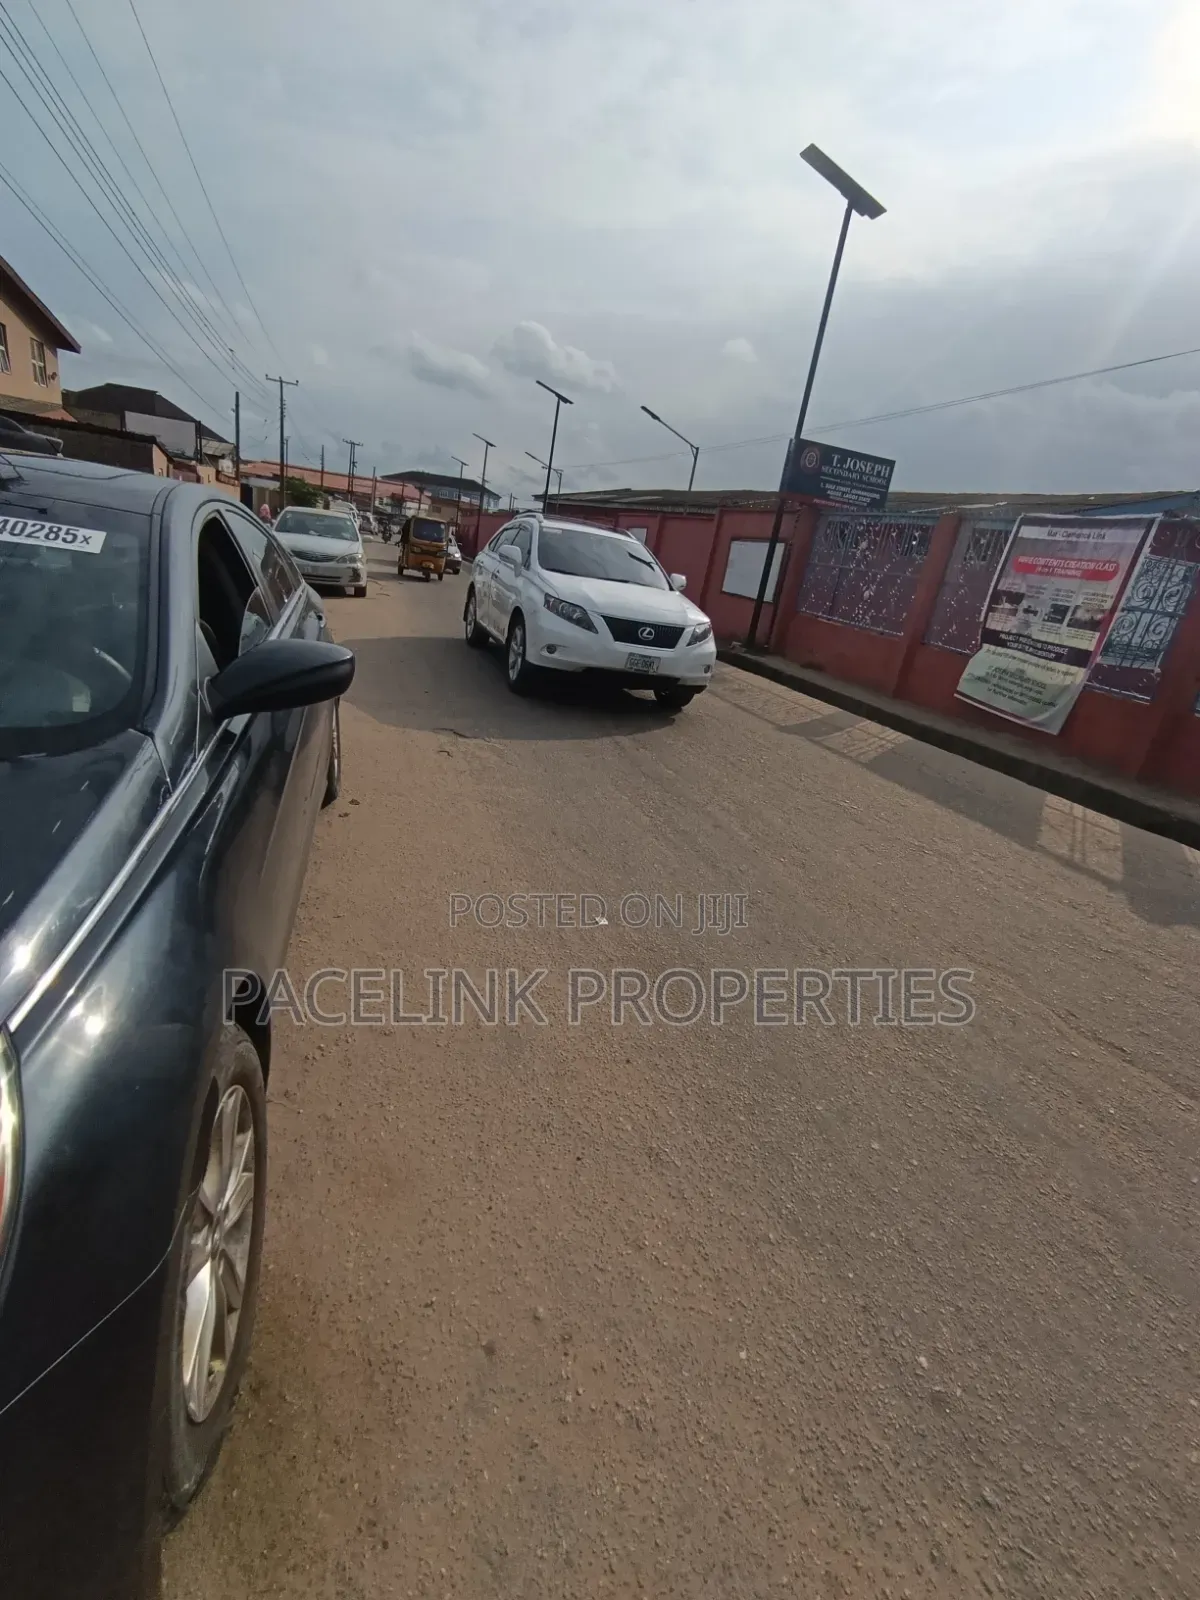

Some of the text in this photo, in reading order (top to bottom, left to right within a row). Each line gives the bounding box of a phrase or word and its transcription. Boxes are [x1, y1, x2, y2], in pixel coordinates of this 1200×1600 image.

[821, 465, 861, 480] SECONDARY
[862, 475, 888, 486] SCHOOL
[843, 457, 891, 478] JOSEPH
[1033, 556, 1065, 568] CONTENTS
[1064, 559, 1095, 570] CREATION
[1095, 562, 1117, 572] CLASS
